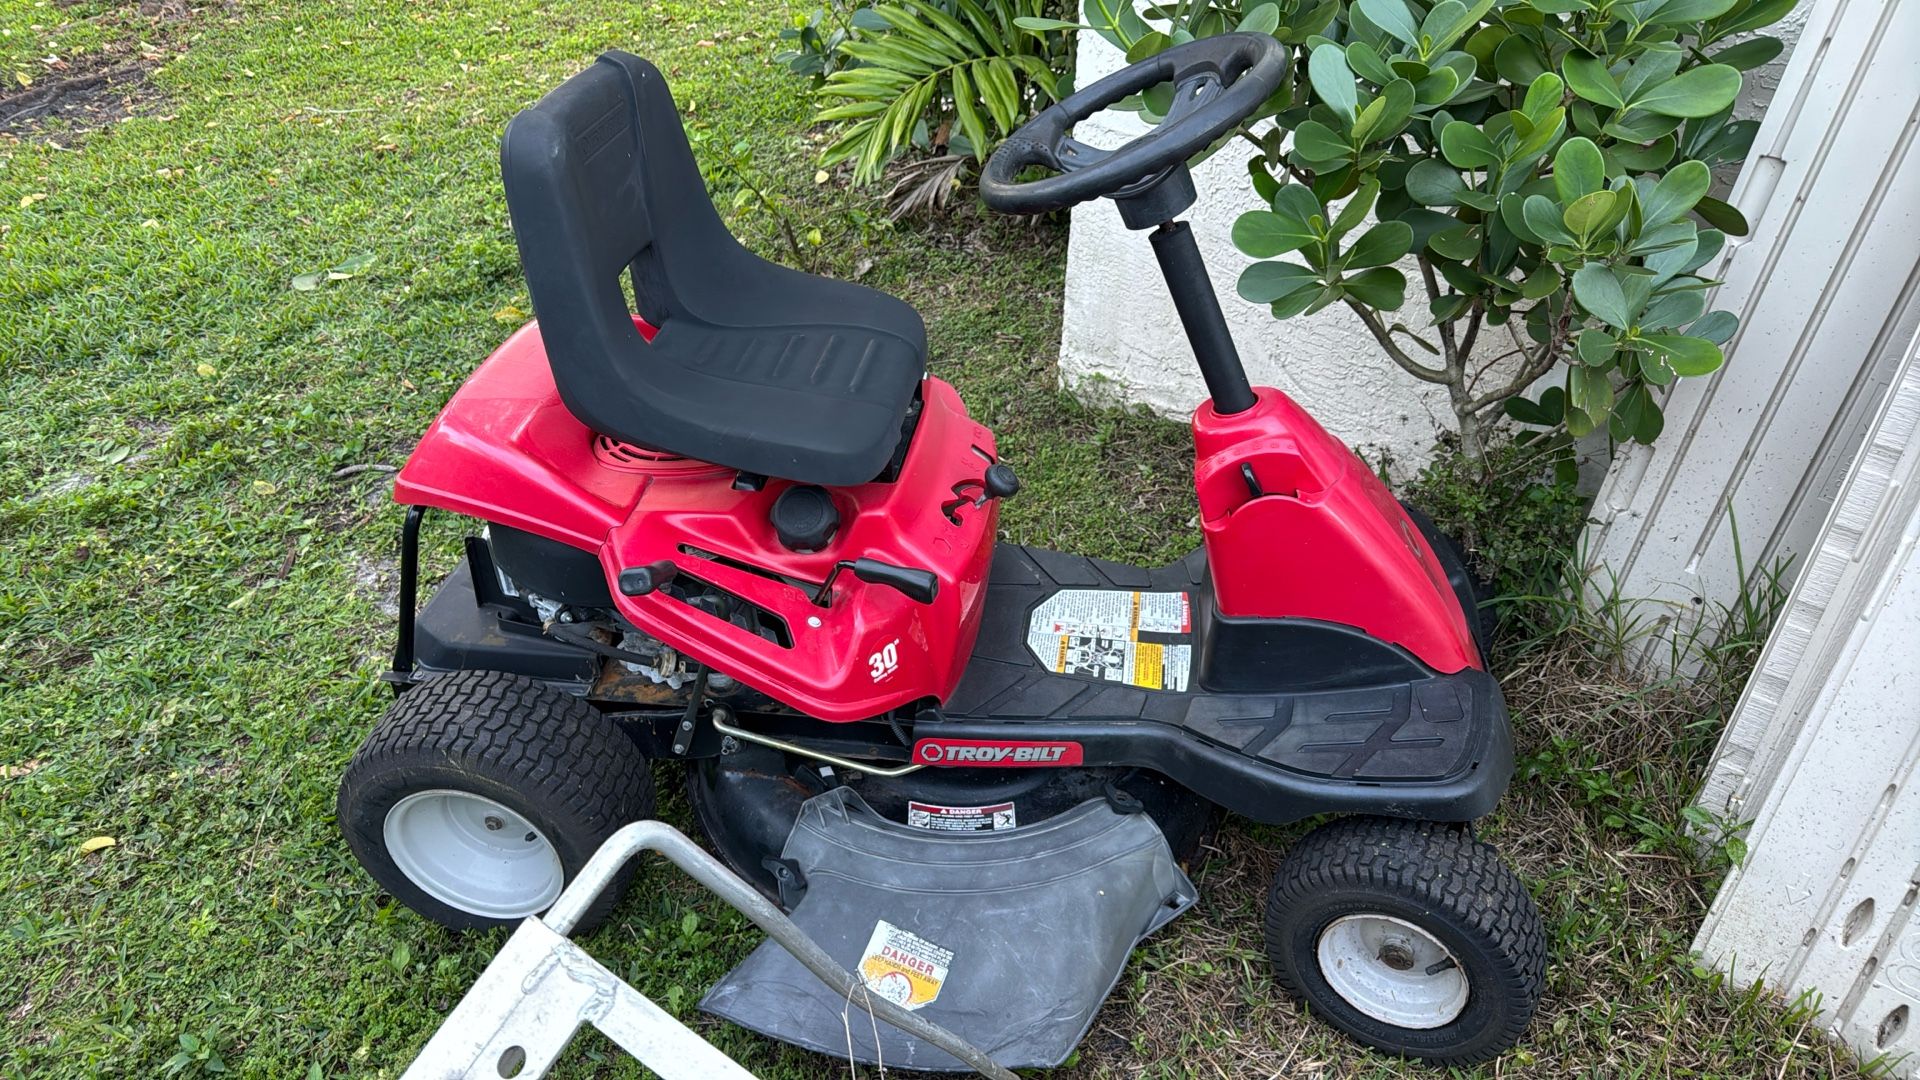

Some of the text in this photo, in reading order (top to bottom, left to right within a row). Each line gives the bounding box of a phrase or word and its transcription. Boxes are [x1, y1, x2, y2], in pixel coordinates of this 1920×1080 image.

[945, 746, 1066, 762] TROY-BILT
[881, 945, 935, 976] DANGER
[901, 965, 911, 973] and
[910, 970, 924, 979] FEET
[923, 976, 938, 986] AWAY
